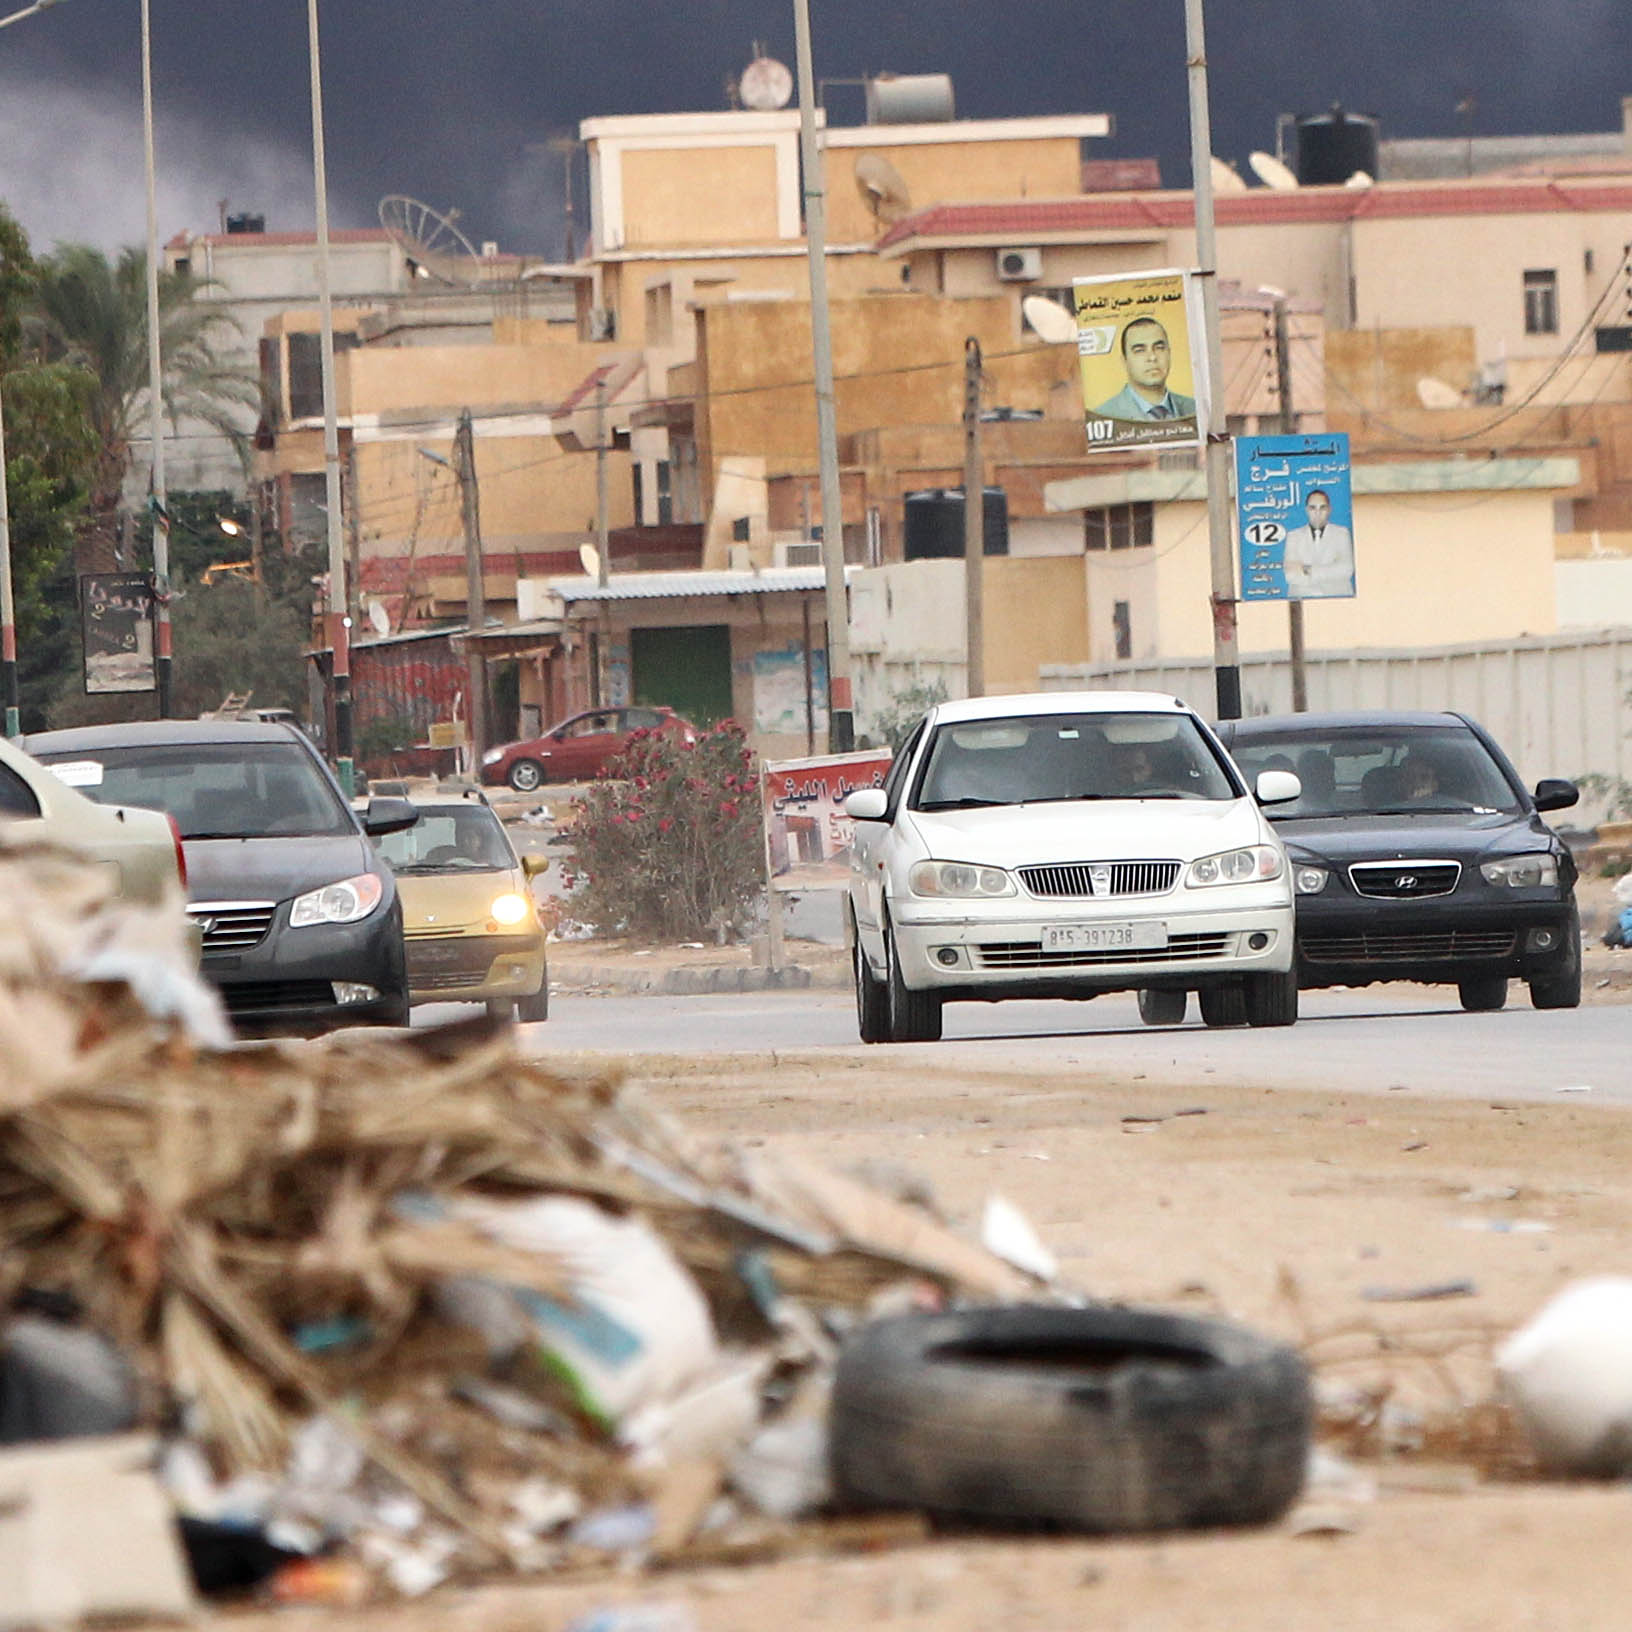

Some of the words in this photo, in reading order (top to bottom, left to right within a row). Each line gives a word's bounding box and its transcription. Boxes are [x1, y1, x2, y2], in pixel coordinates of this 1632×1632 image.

[1086, 420, 1114, 441] 107
[1251, 459, 1290, 482] فرج
[1249, 523, 1280, 543] 12
